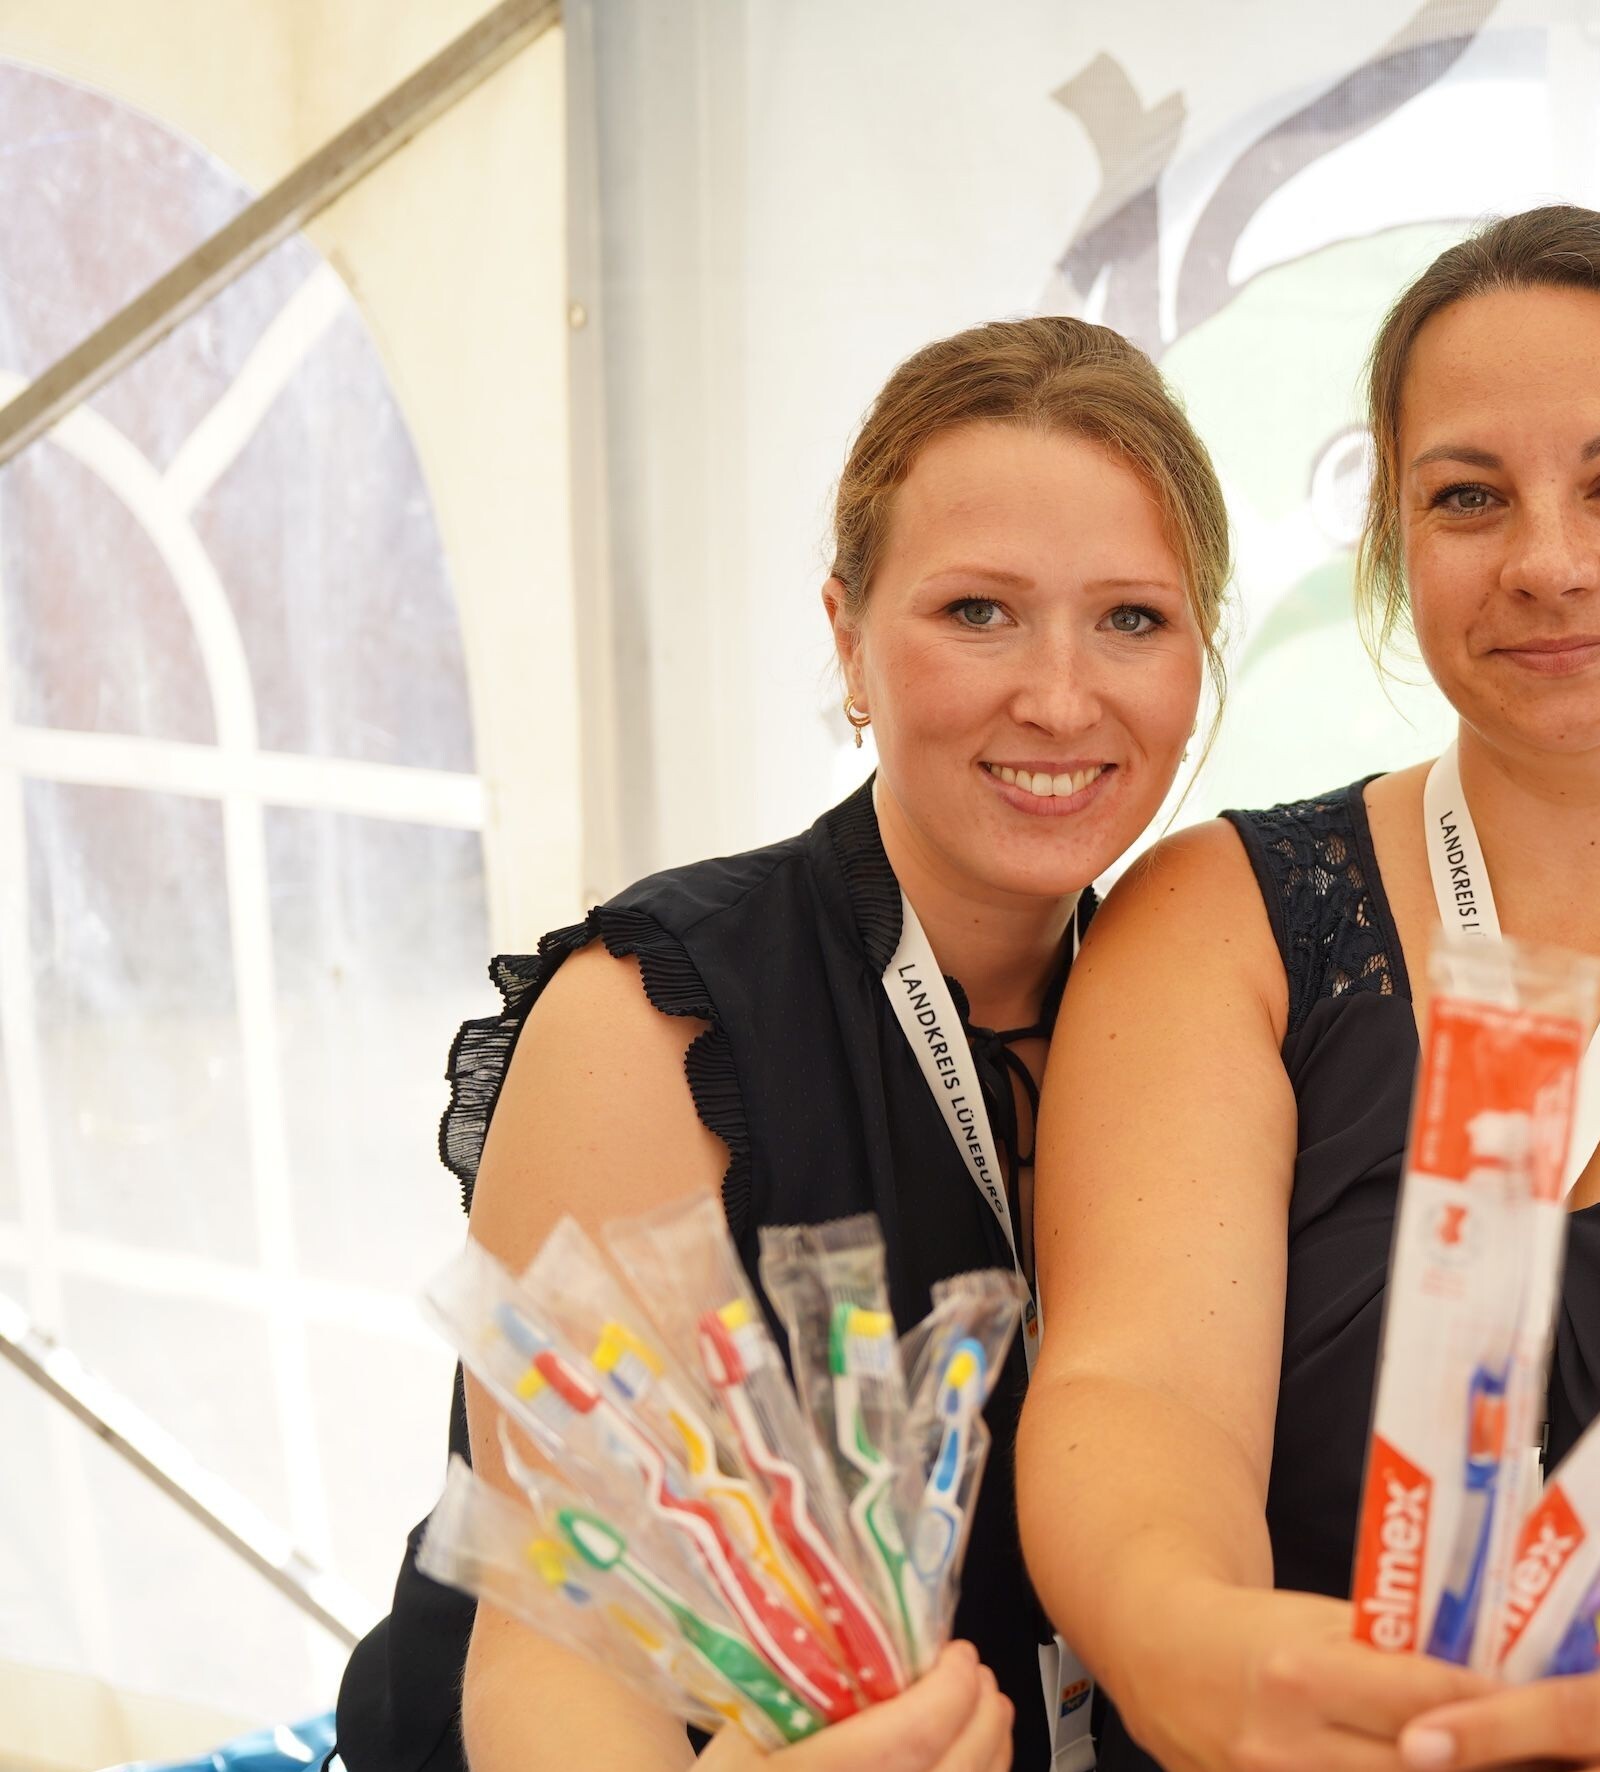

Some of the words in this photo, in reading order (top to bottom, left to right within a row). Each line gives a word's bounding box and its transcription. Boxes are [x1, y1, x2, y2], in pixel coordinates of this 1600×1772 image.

[1439, 810, 1477, 917] LANDKREIS
[898, 964, 961, 1090] LANDKREIS
[951, 1096, 1004, 1213] LÜNEBURG
[1361, 1480, 1426, 1650] elmex
